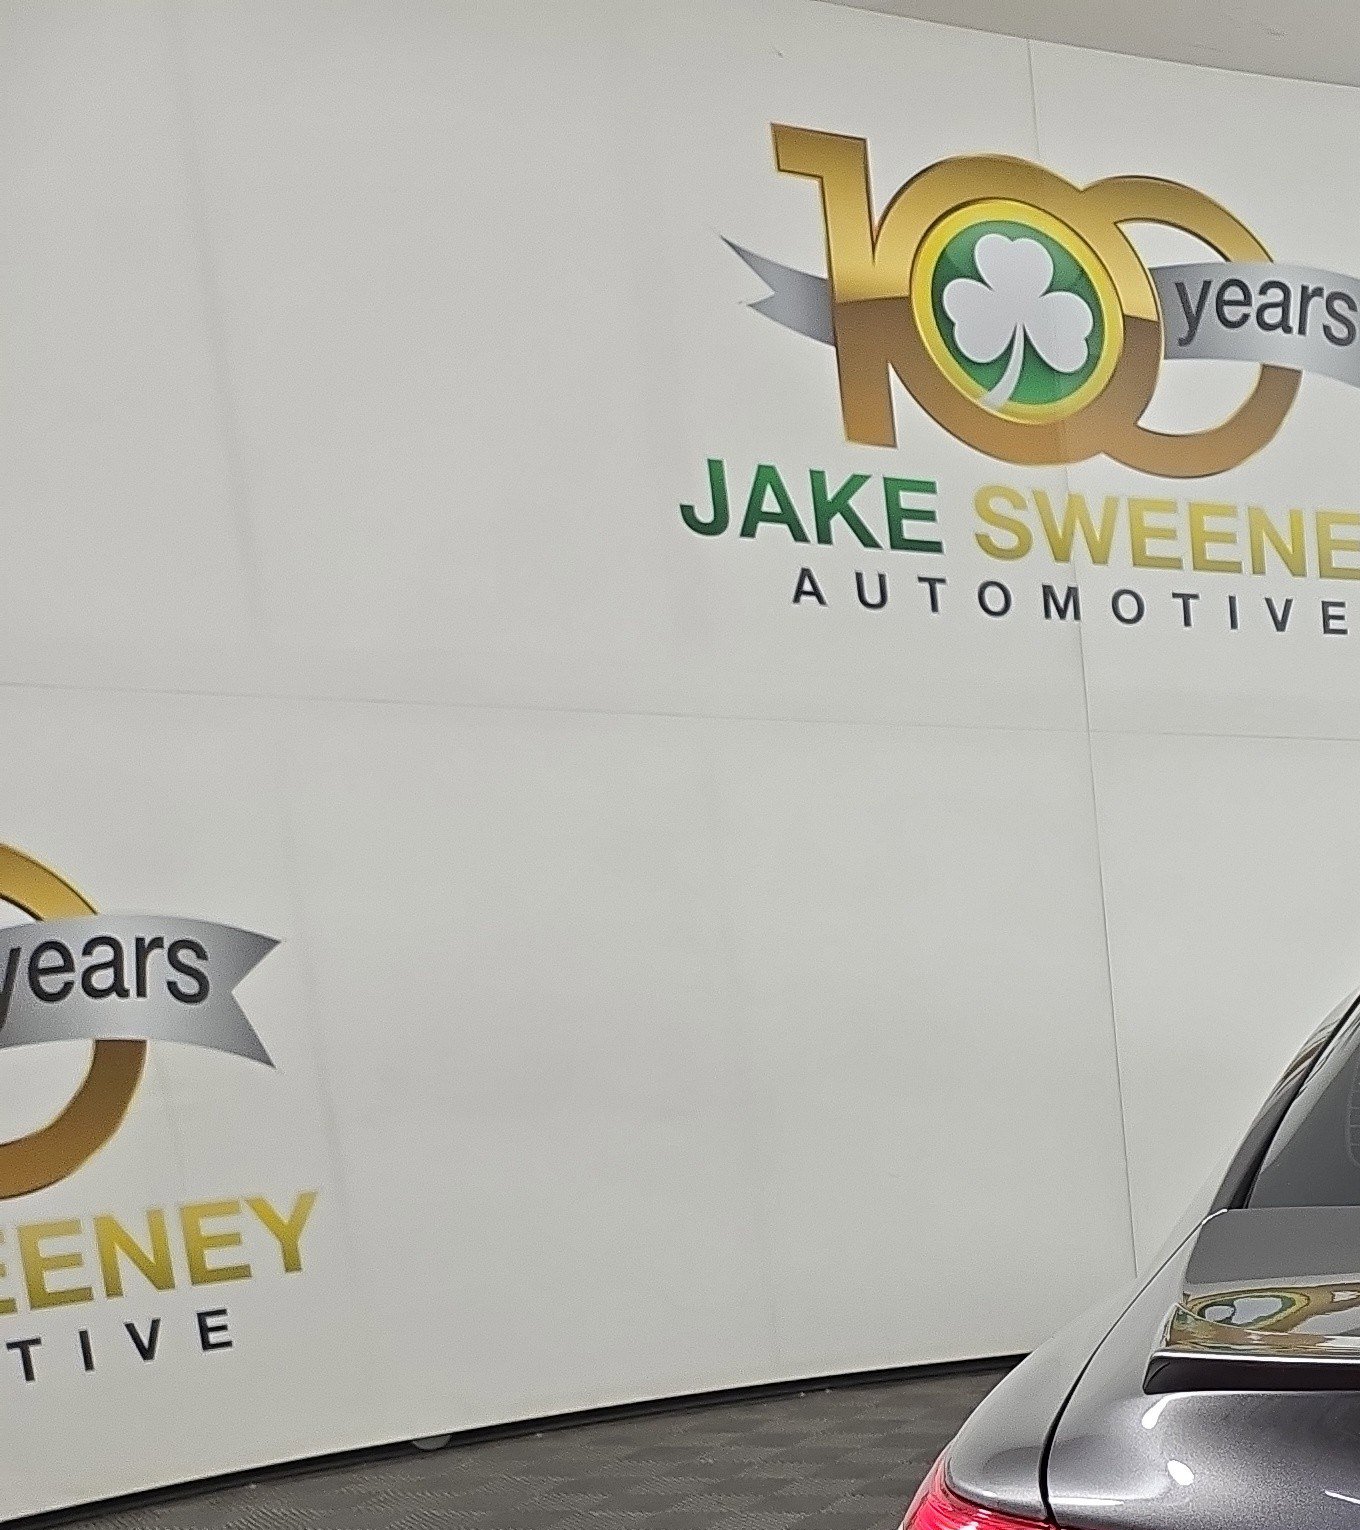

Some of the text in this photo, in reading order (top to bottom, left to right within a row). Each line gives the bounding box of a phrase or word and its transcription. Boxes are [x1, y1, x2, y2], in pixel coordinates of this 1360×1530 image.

[1174, 277, 1359, 348] years
[679, 458, 944, 555] JAKE
[792, 567, 1349, 636] AUTOMOTIVE
[0, 1191, 317, 1316] ENEY
